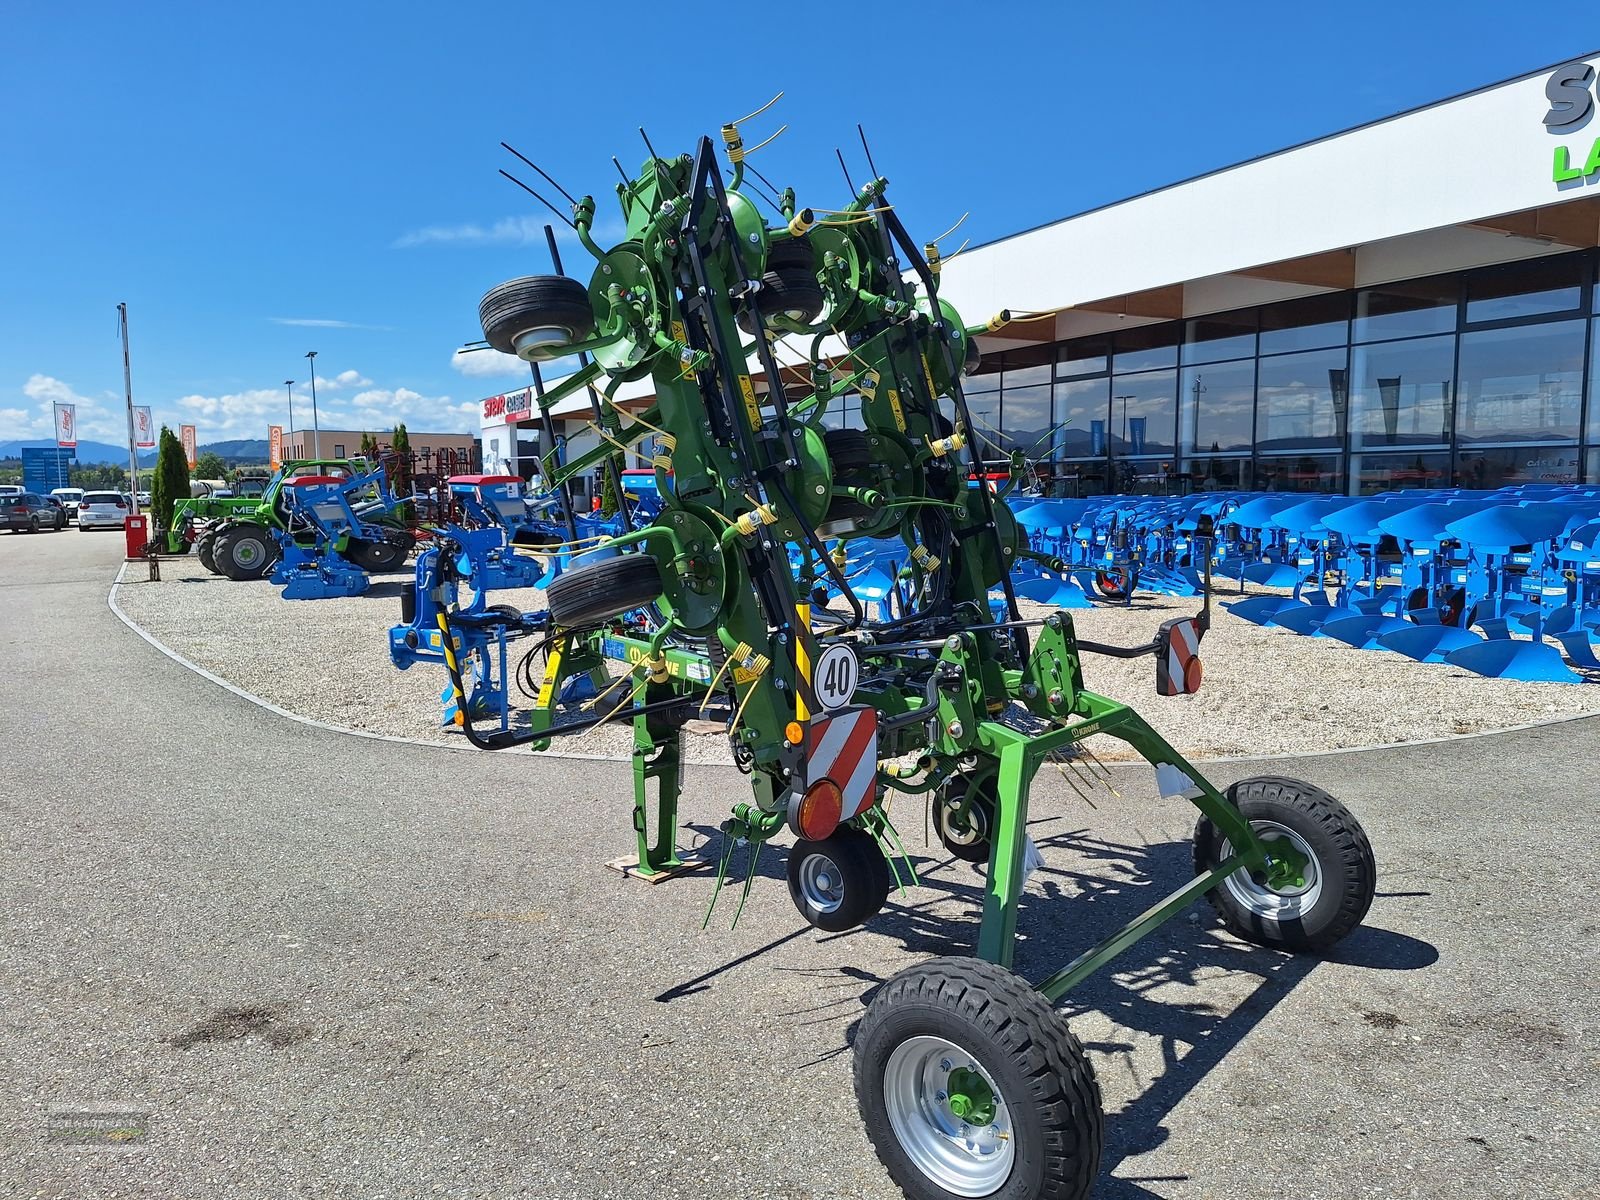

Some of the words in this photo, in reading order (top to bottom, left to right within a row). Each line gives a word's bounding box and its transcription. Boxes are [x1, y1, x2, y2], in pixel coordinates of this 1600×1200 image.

[1542, 63, 1600, 135] S
[232, 506, 256, 514] ME
[824, 656, 850, 697] 40
[1078, 722, 1100, 736] KRONE
